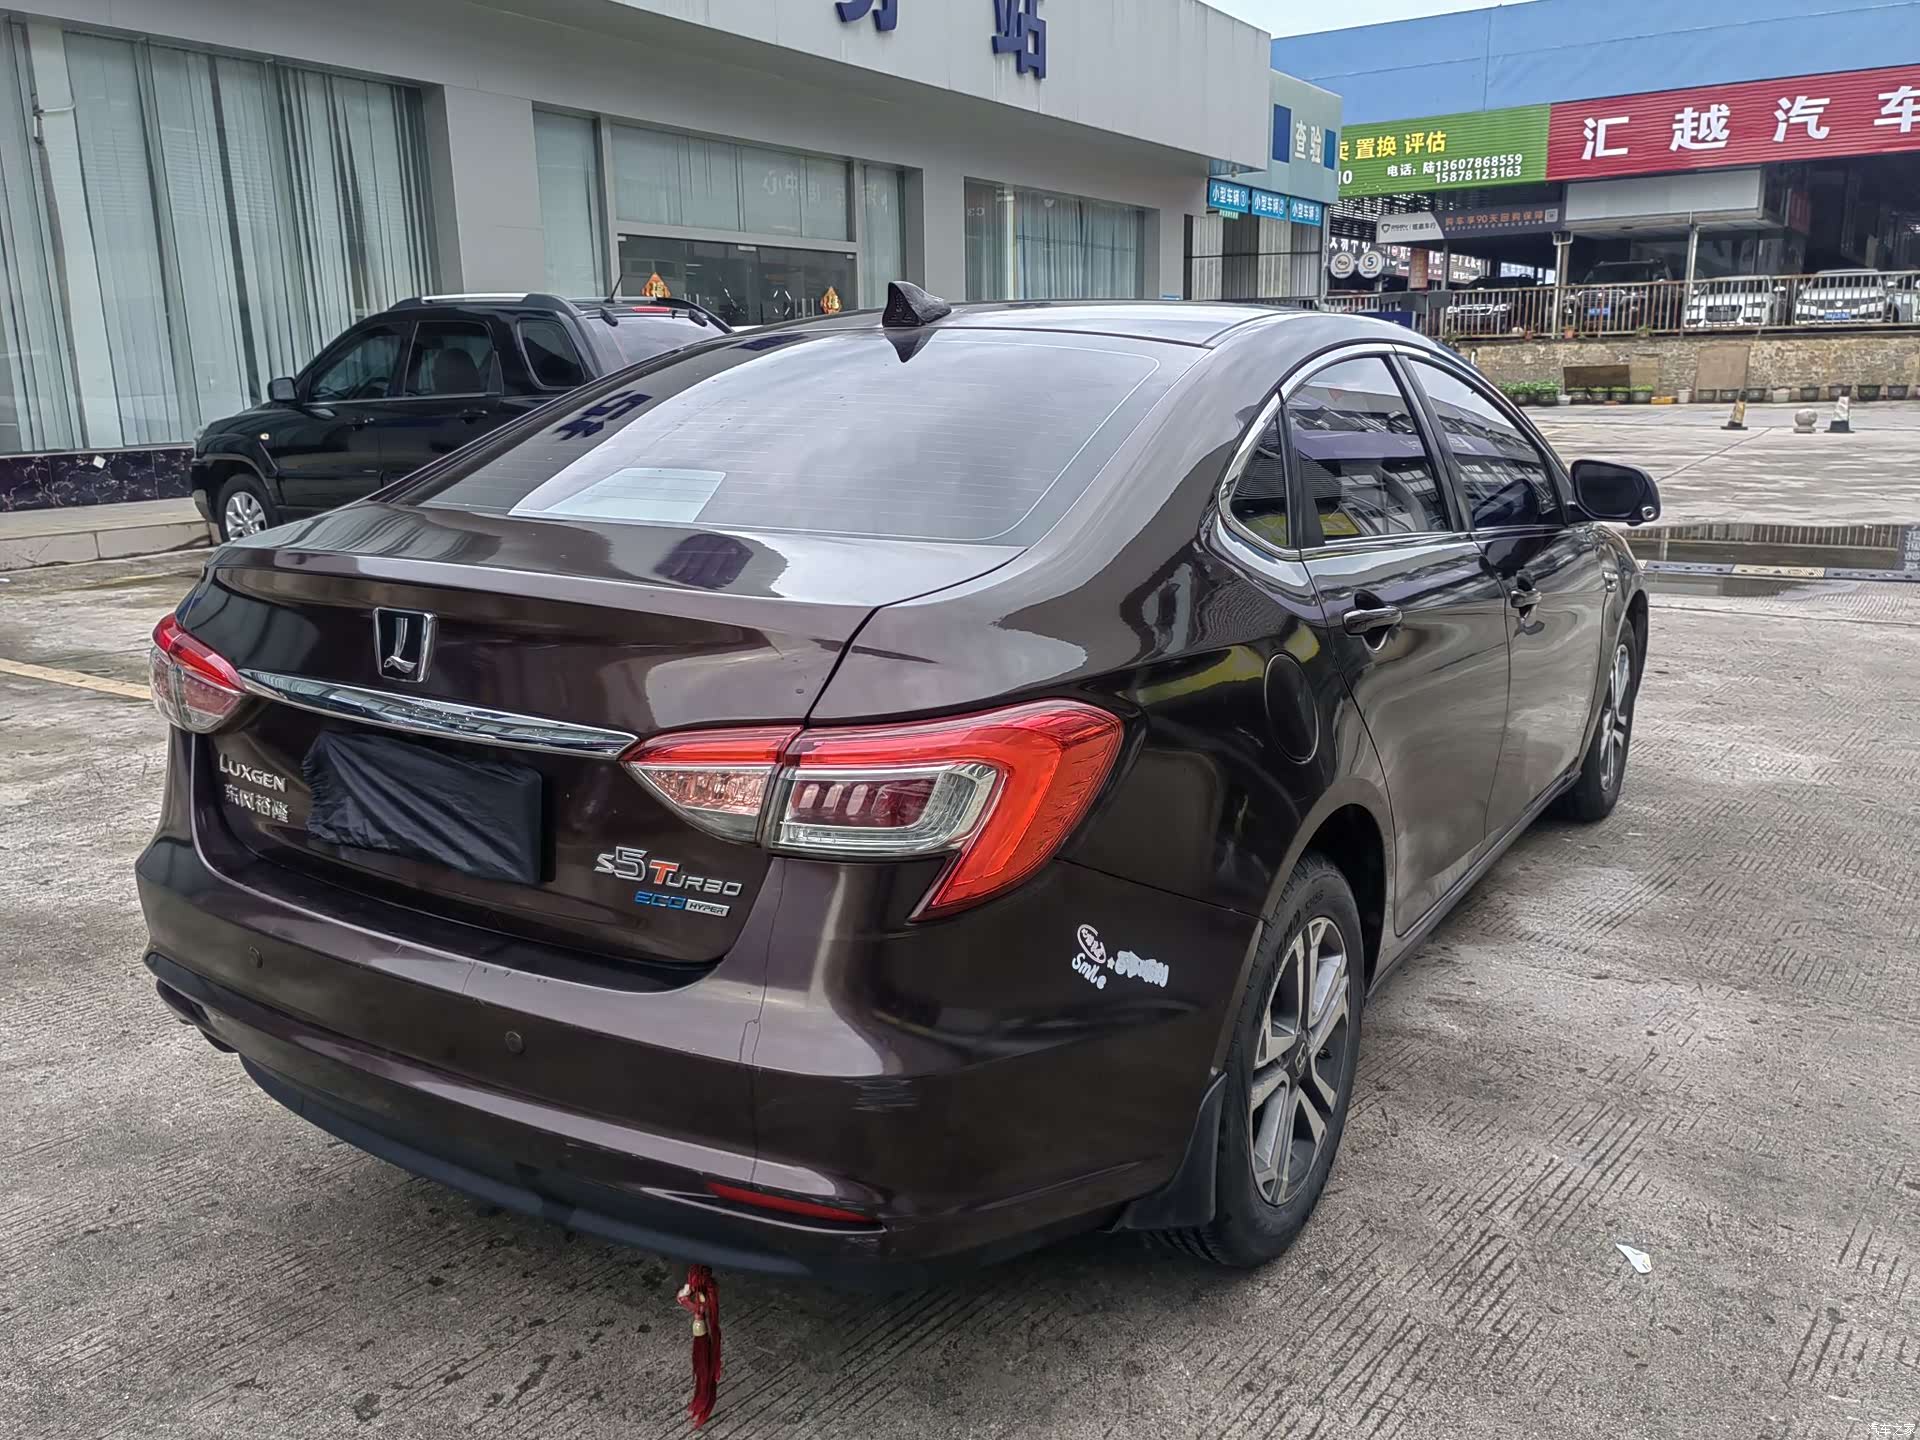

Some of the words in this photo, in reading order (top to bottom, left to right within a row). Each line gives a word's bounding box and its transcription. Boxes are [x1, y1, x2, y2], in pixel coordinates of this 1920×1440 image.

[1295, 119, 1322, 163] 查验
[1581, 86, 1920, 160] 汇越汽车
[1355, 136, 1397, 160] 置换
[1404, 131, 1446, 155] 评估
[1435, 166, 1521, 183] 15878123163
[219, 753, 286, 792] LUXGEN
[224, 784, 289, 823] 东风裕隆
[634, 890, 687, 910] ECO
[688, 902, 728, 915] HYPER
